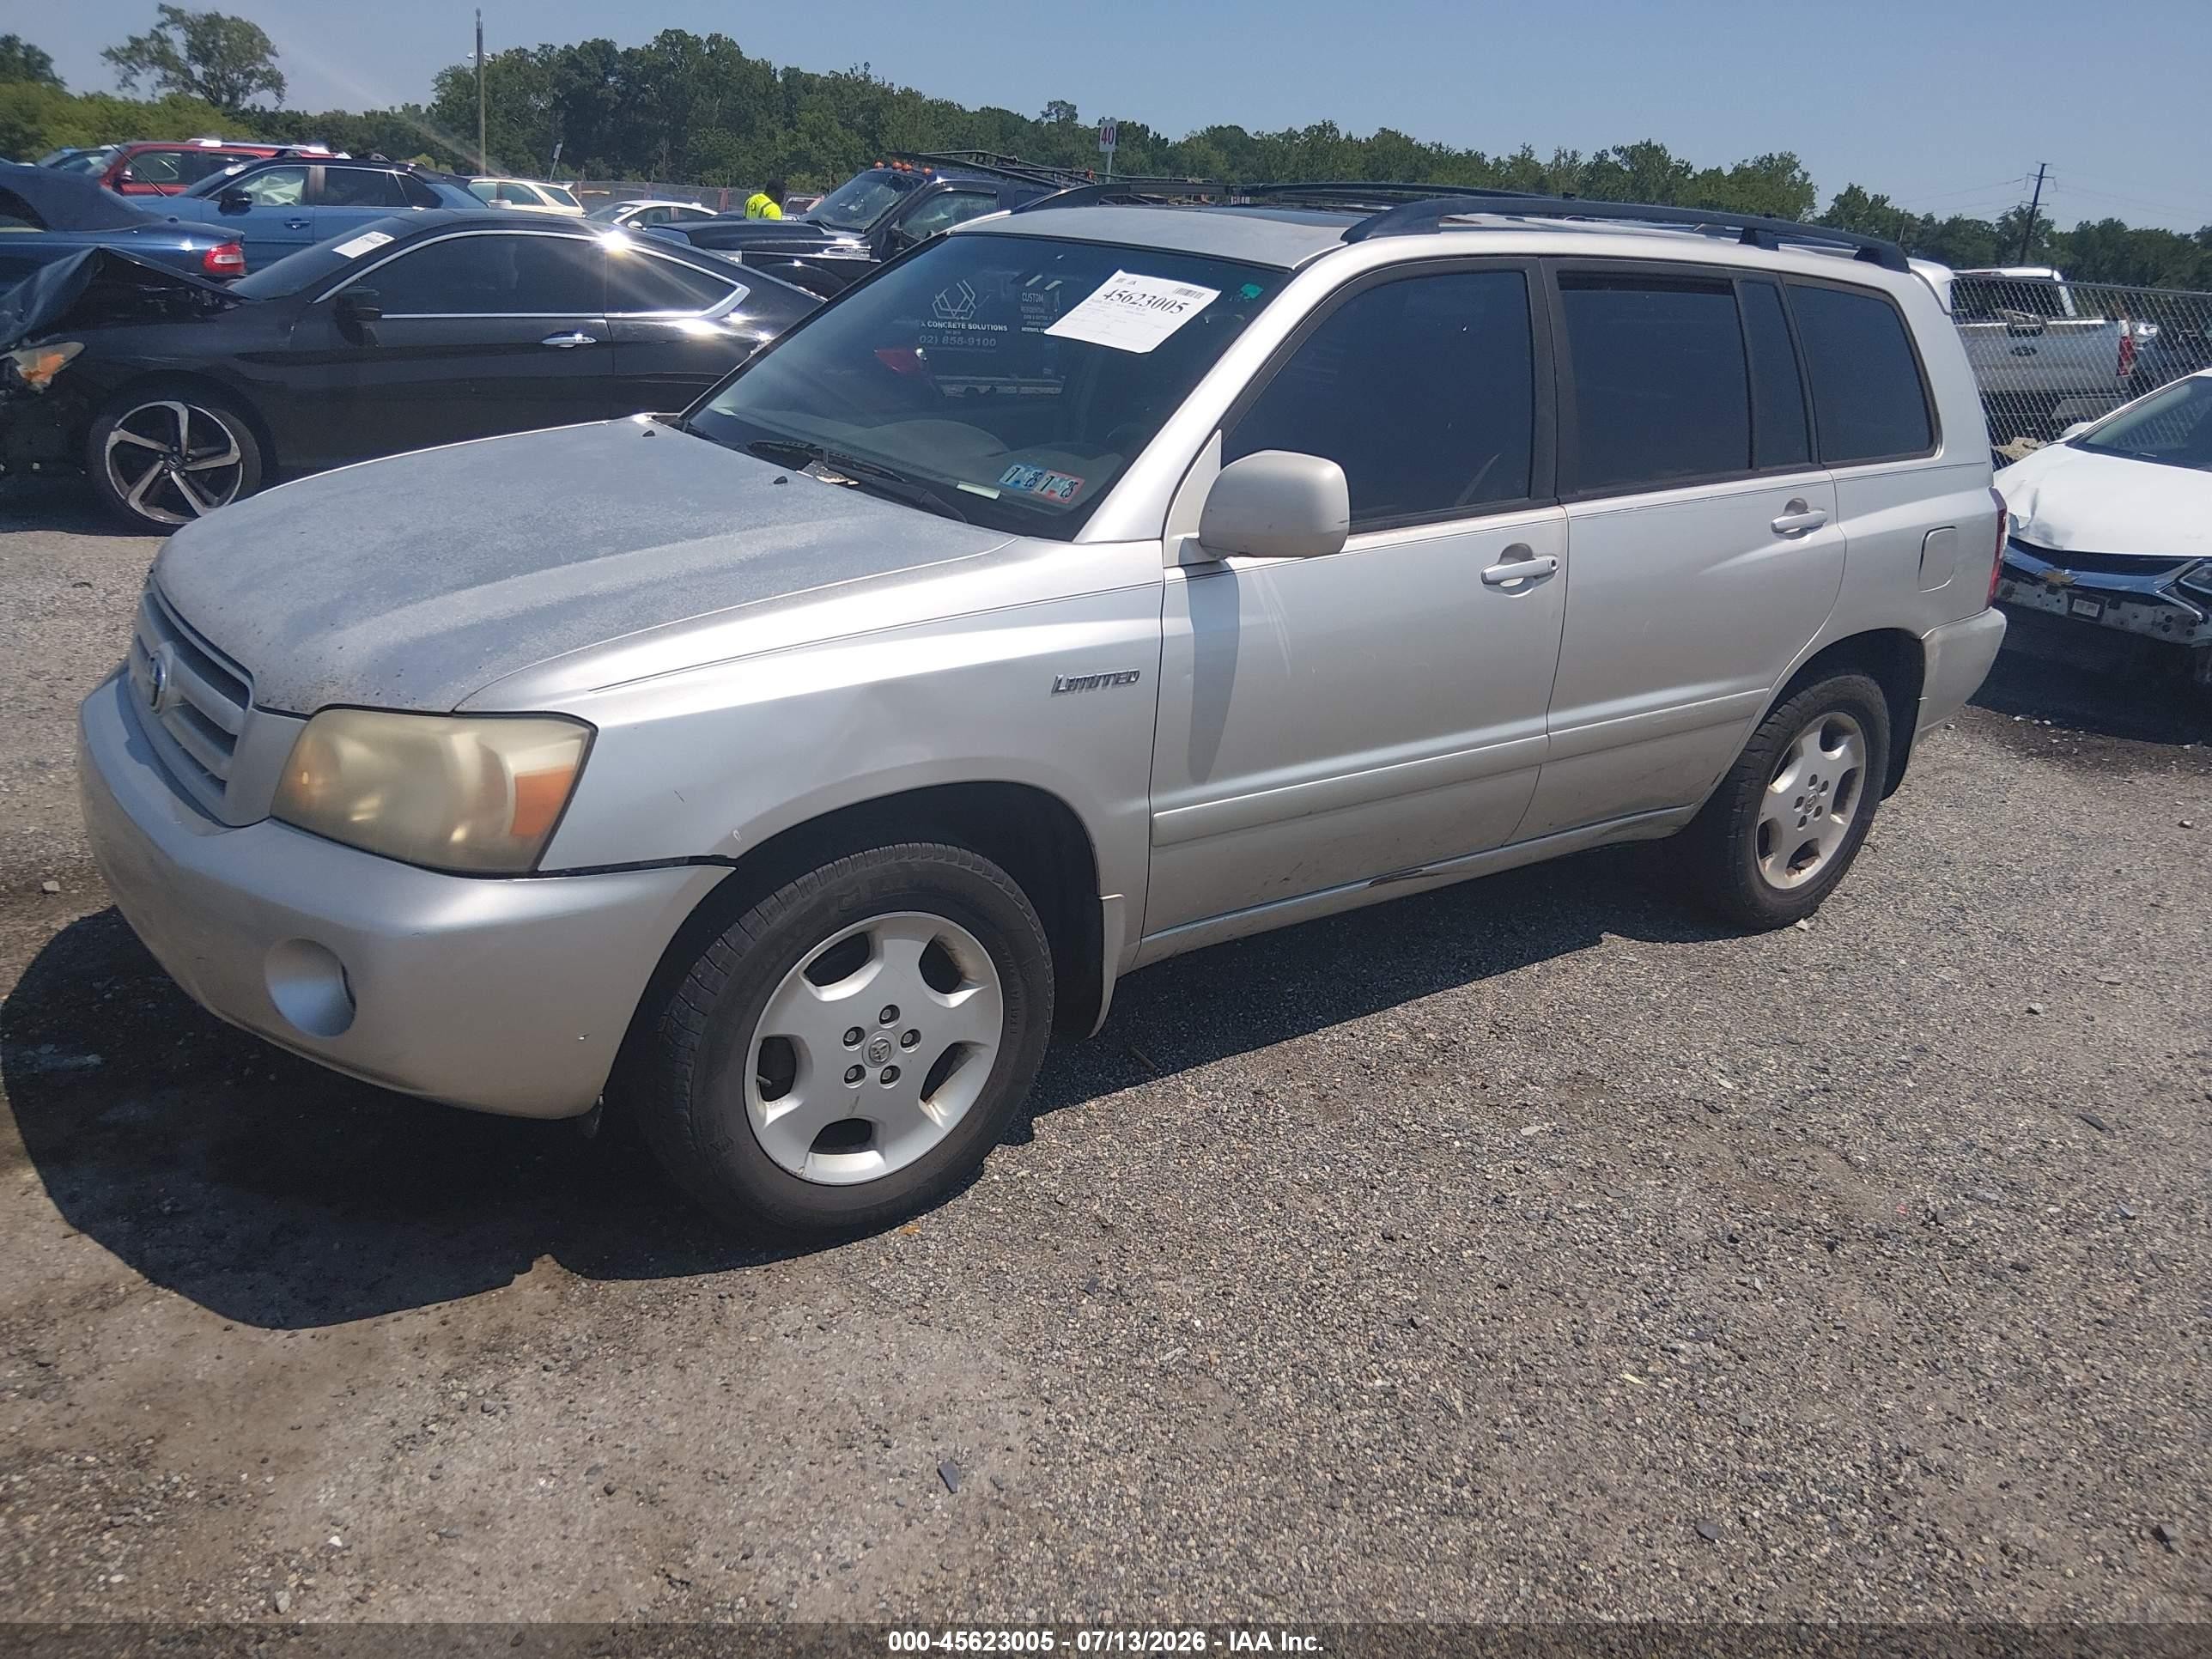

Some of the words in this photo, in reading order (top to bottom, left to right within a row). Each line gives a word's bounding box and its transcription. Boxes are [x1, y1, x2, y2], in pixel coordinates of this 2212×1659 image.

[1102, 126, 1115, 145] 40
[1022, 293, 1045, 303] CUSTOM
[1103, 289, 1191, 314] 45623005
[927, 320, 967, 330] CONCRETE
[920, 335, 938, 344] 02)
[1053, 668, 1140, 694] LIMITED
